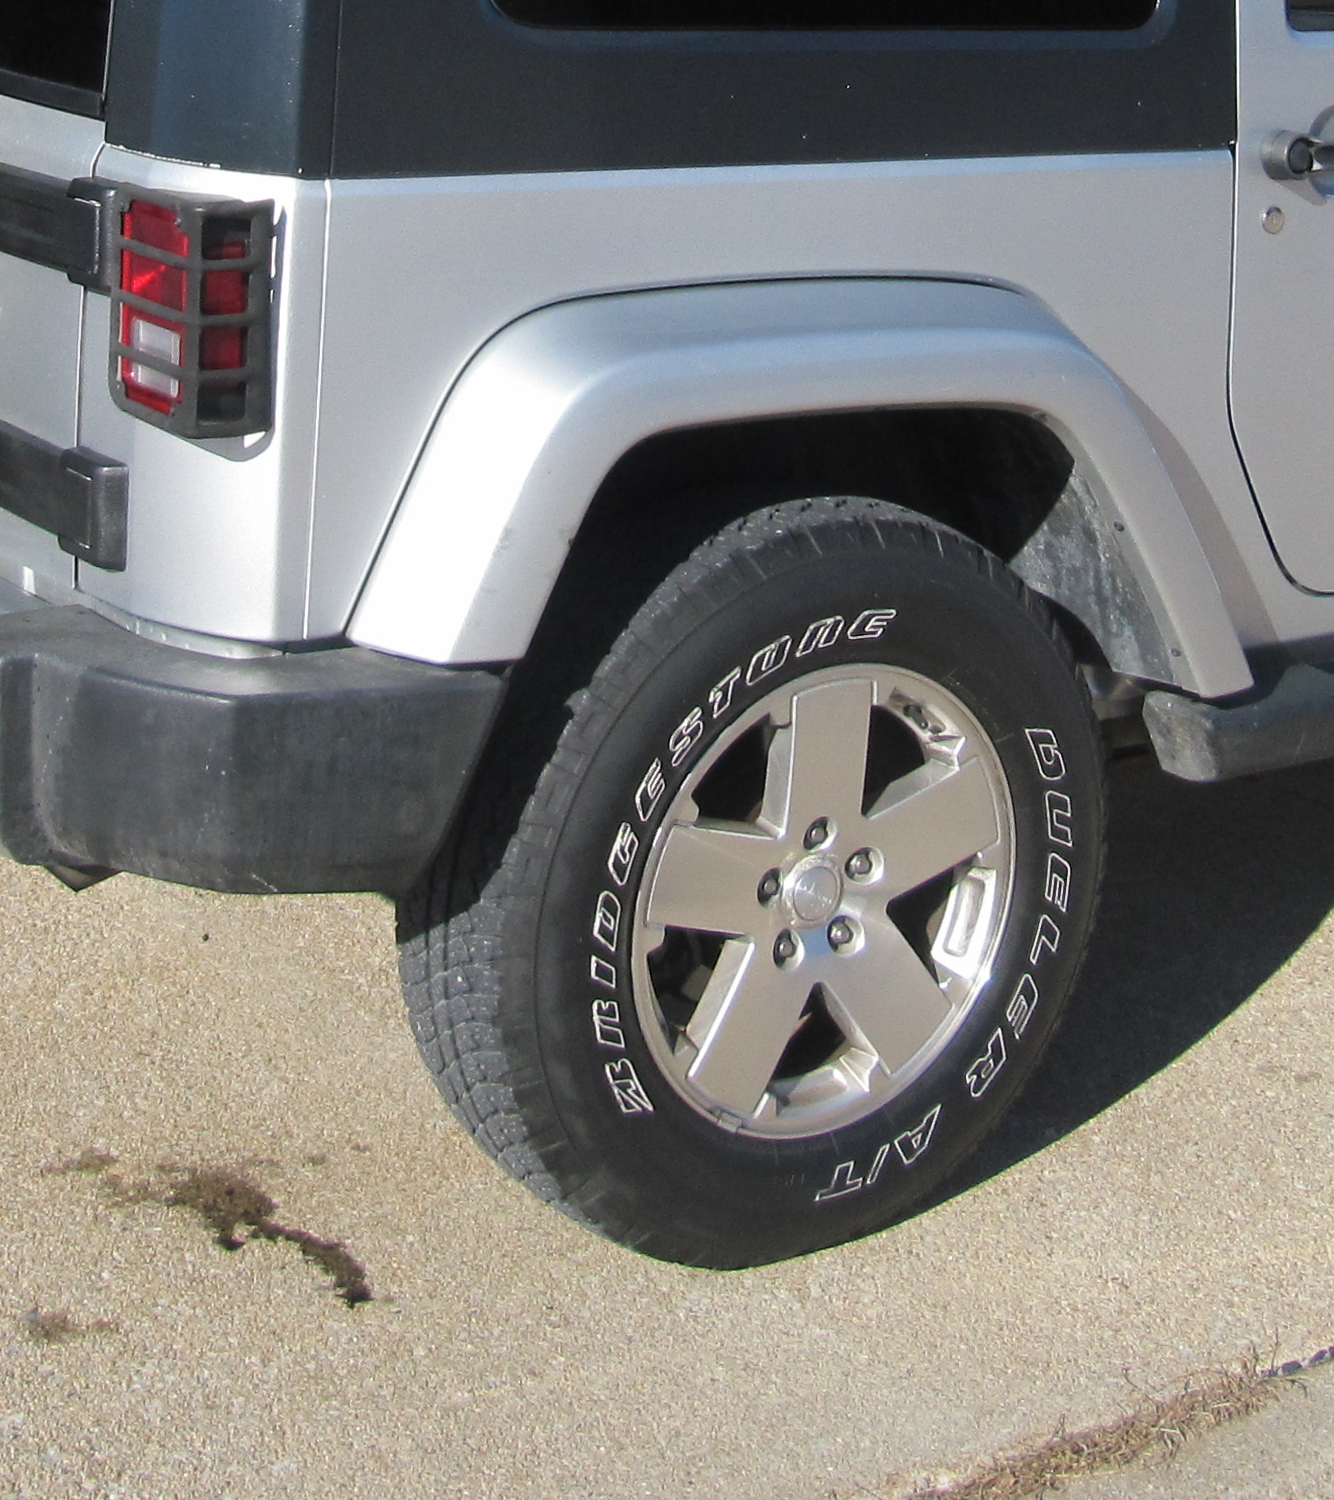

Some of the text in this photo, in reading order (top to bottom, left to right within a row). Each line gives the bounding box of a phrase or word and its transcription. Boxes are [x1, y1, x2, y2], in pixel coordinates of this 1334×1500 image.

[591, 608, 896, 1114] BRIDGESTONE
[815, 727, 1073, 1201] DUELER A/T
